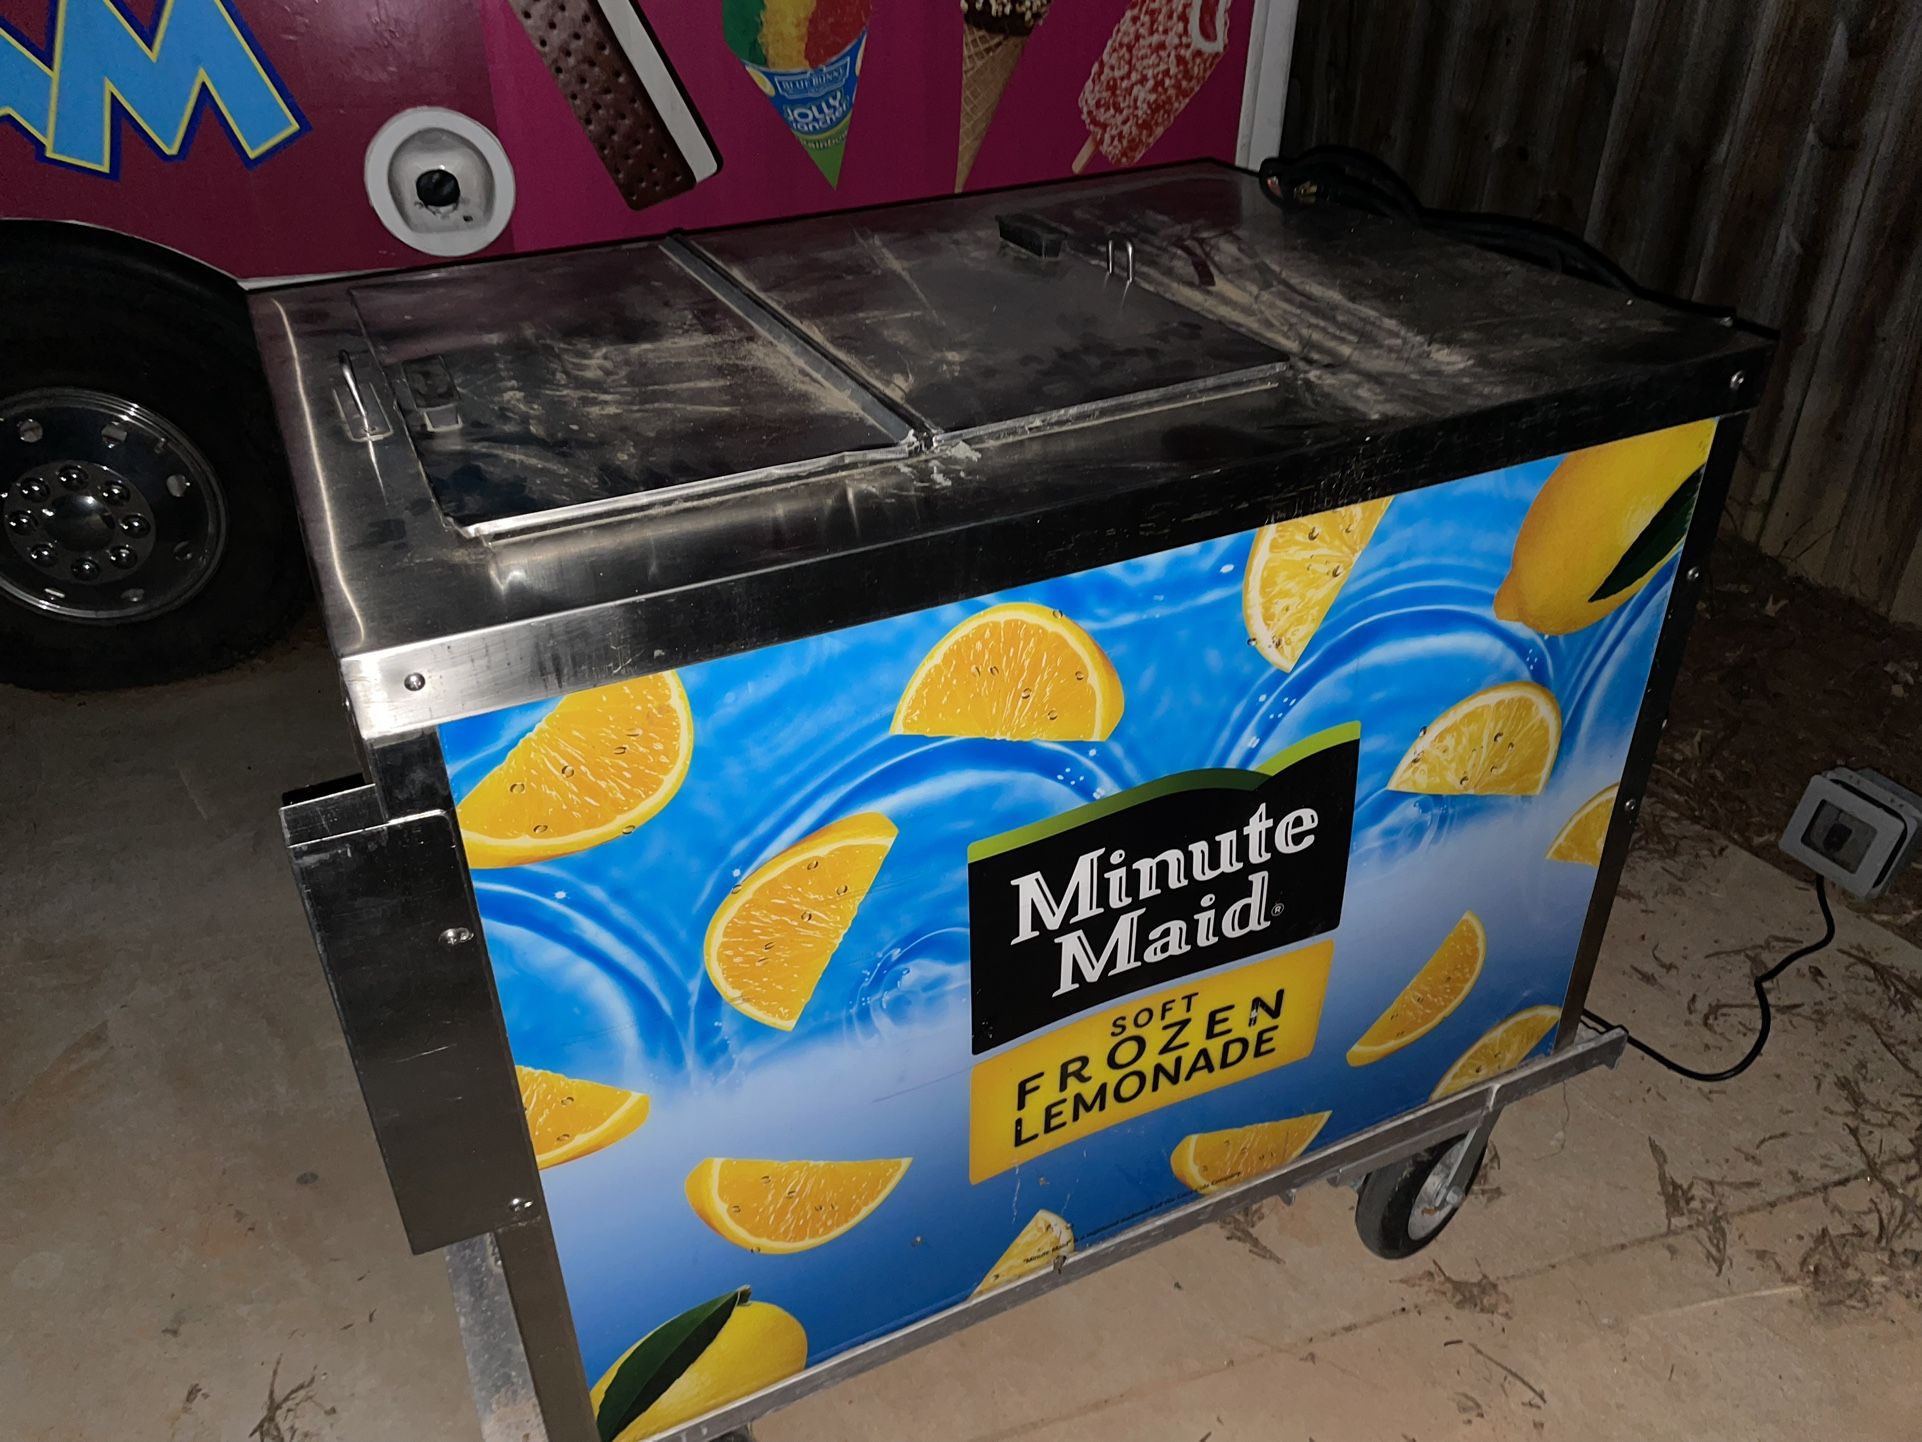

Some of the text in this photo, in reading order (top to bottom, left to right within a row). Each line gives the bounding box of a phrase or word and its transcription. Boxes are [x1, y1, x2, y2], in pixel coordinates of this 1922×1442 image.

[784, 90, 842, 122] JOLLY
[1010, 802, 1319, 946] Minute
[1016, 988, 1286, 1112] FROZEN
[1110, 992, 1199, 1037] SOFT
[1013, 1025, 1280, 1148] LEMONADE
